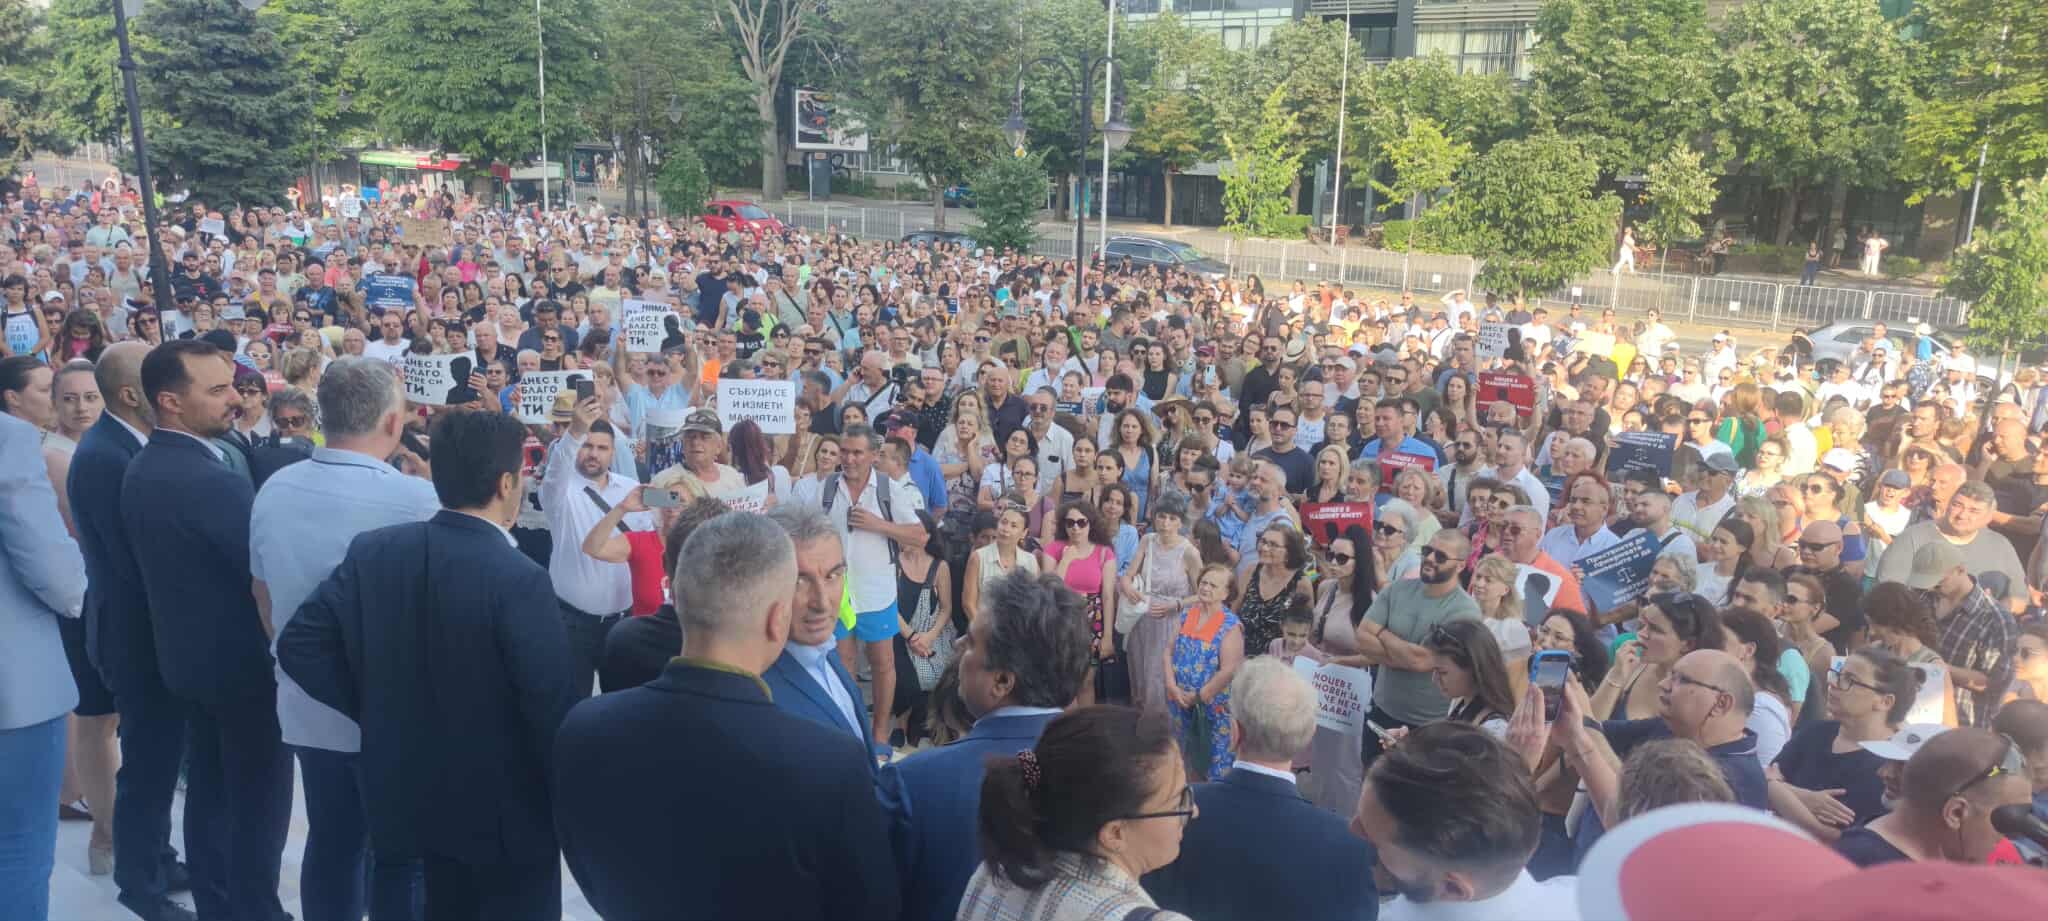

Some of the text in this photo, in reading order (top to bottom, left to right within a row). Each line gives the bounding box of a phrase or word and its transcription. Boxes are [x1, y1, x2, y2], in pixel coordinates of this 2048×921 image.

[437, 360, 442, 368] Е
[521, 376, 560, 385] ДНЕС Е
[405, 382, 431, 397] ТИ.
[728, 387, 788, 397] СЪБУДИ СЕ
[732, 400, 784, 410] И ИЗМЕТИ
[1338, 698, 1348, 708] НЕ
[1351, 702, 1361, 712] СЕ
